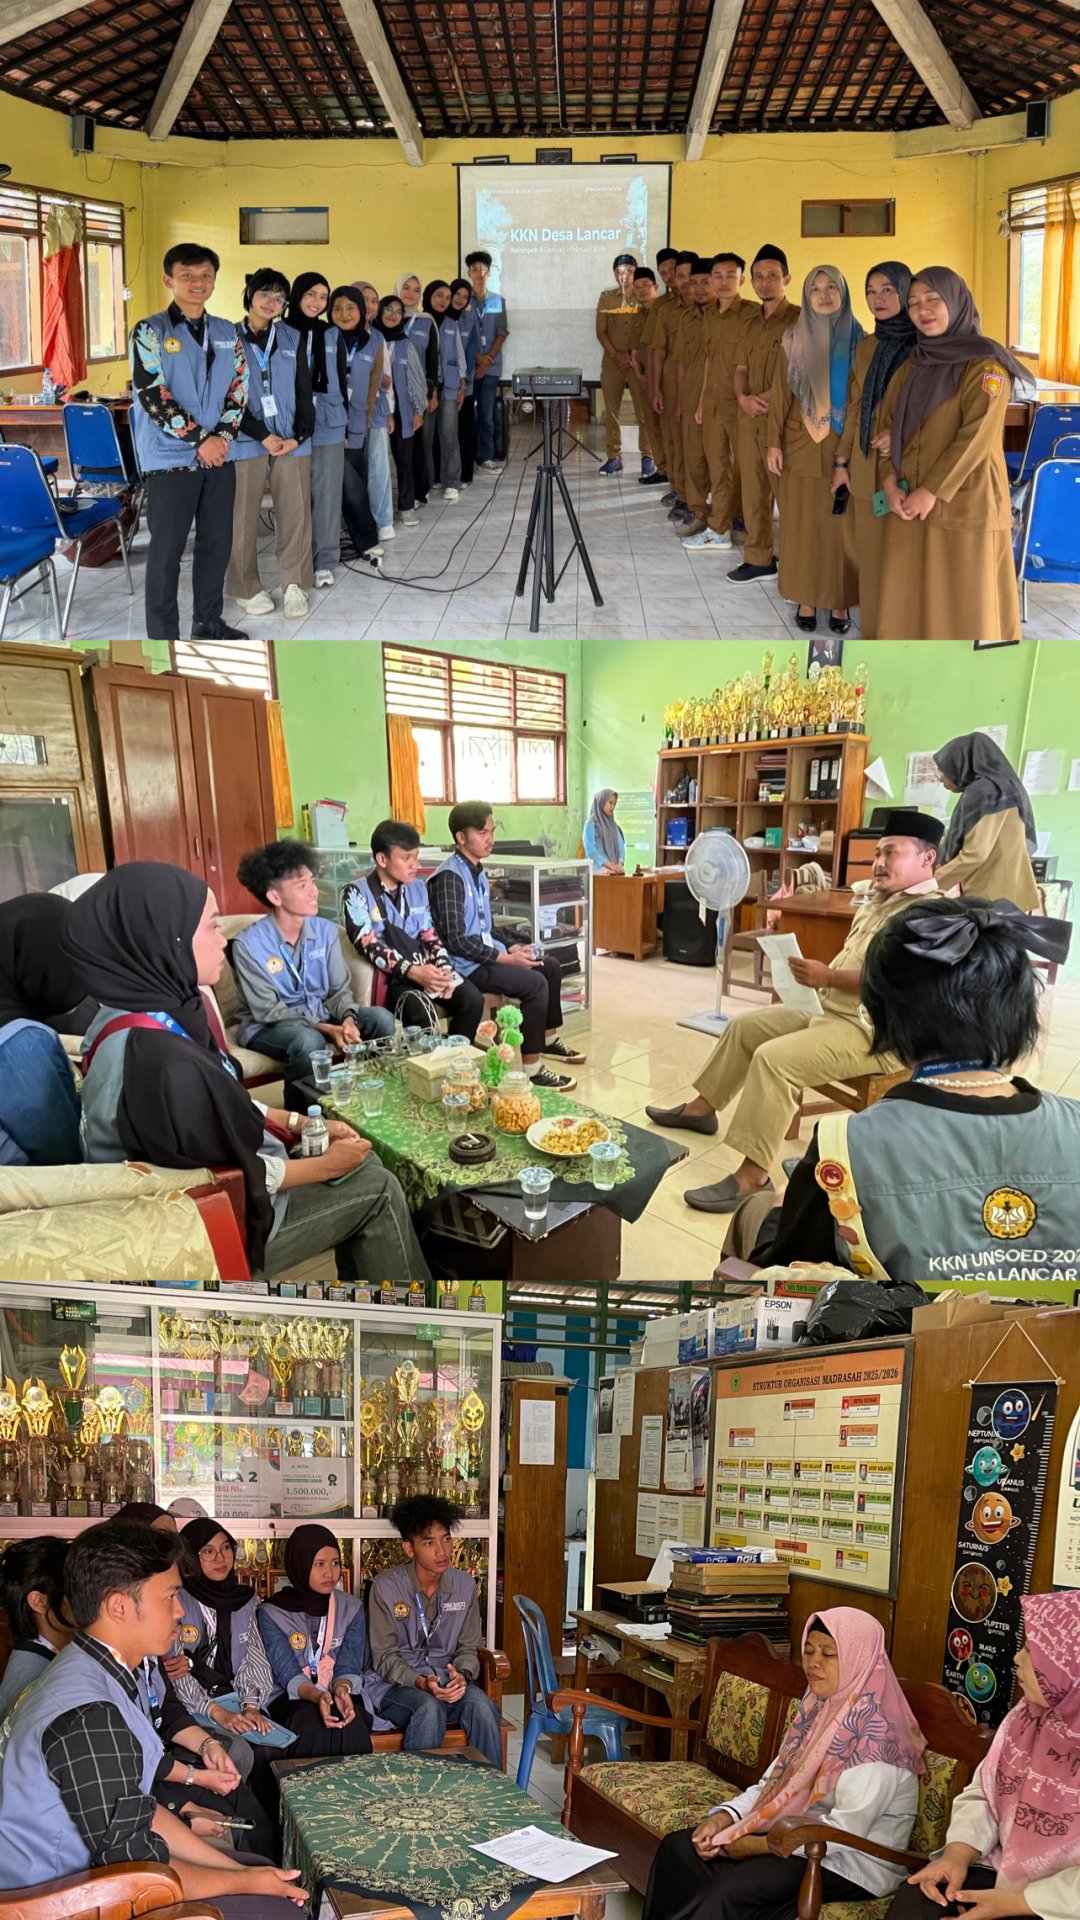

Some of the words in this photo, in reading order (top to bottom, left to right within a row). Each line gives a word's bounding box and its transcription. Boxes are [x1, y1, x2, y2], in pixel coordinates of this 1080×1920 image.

[511, 229, 537, 241] KKN
[542, 228, 573, 241] Desa
[577, 227, 621, 240] Lancar
[929, 1254, 967, 1272] KKN
[971, 1249, 1047, 1267] UNSOED
[764, 1299, 792, 1309] EPSON
[752, 1380, 782, 1391] STRUKTUR
[784, 1376, 820, 1388] ORGANISASI
[822, 1372, 862, 1384] MADRASAH
[863, 1368, 898, 1381] 2025/2026
[248, 1471, 257, 1482] 2
[958, 1541, 989, 1552] SATURNUS
[984, 1620, 1010, 1631] JUPITER
[979, 1643, 997, 1654] MARS
[945, 1669, 964, 1680] EARTH
